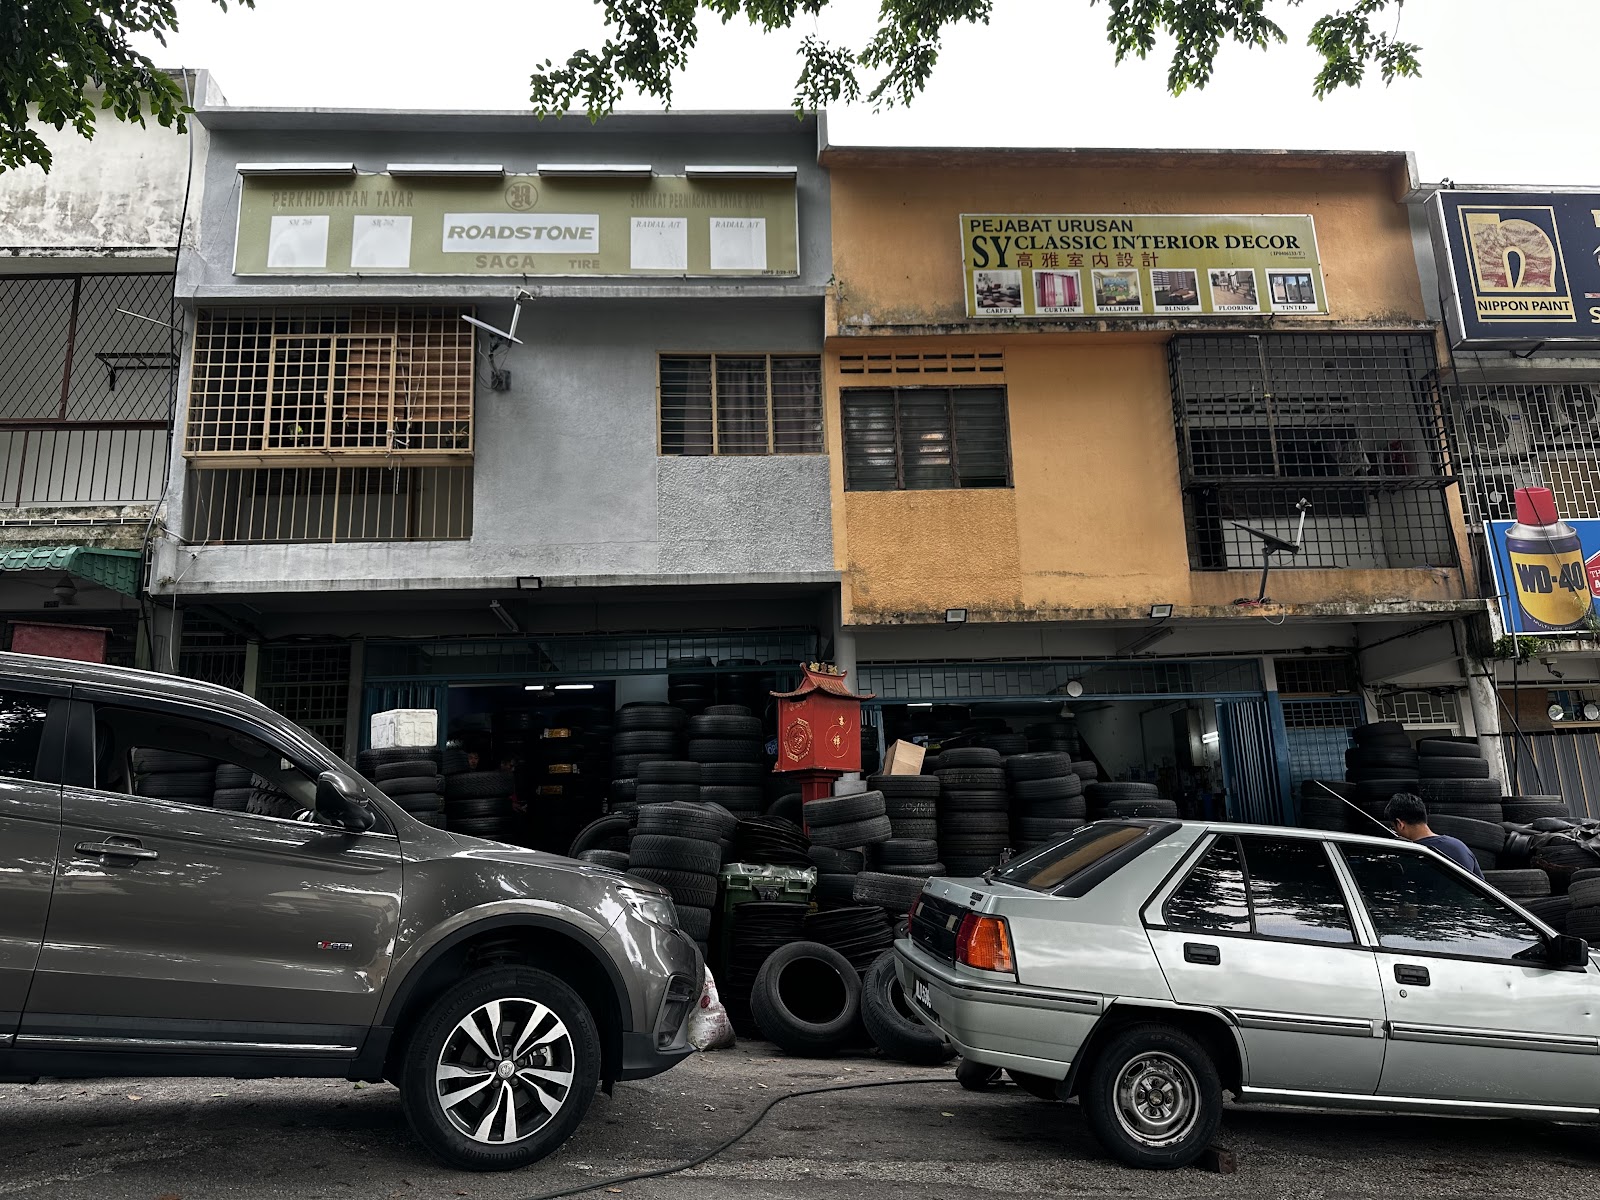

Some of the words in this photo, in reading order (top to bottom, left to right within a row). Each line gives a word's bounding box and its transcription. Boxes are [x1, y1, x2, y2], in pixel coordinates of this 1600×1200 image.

[272, 190, 368, 207] PERKHIDMATAN
[376, 190, 414, 207] TAYAR
[630, 192, 667, 208] SYARIKAT
[447, 225, 595, 240] ROADSTONE
[970, 219, 1052, 233] PEJABAT
[1057, 219, 1133, 233] URUSAN
[1014, 235, 1107, 250] CLASSIC
[1112, 235, 1220, 250] INTERIOR
[1224, 235, 1300, 250] DECOR
[972, 235, 1011, 268] SY
[475, 255, 535, 269] SAGA
[568, 259, 600, 269] TIRE
[1478, 300, 1529, 311] NIPPON
[1531, 300, 1570, 311] PAINT
